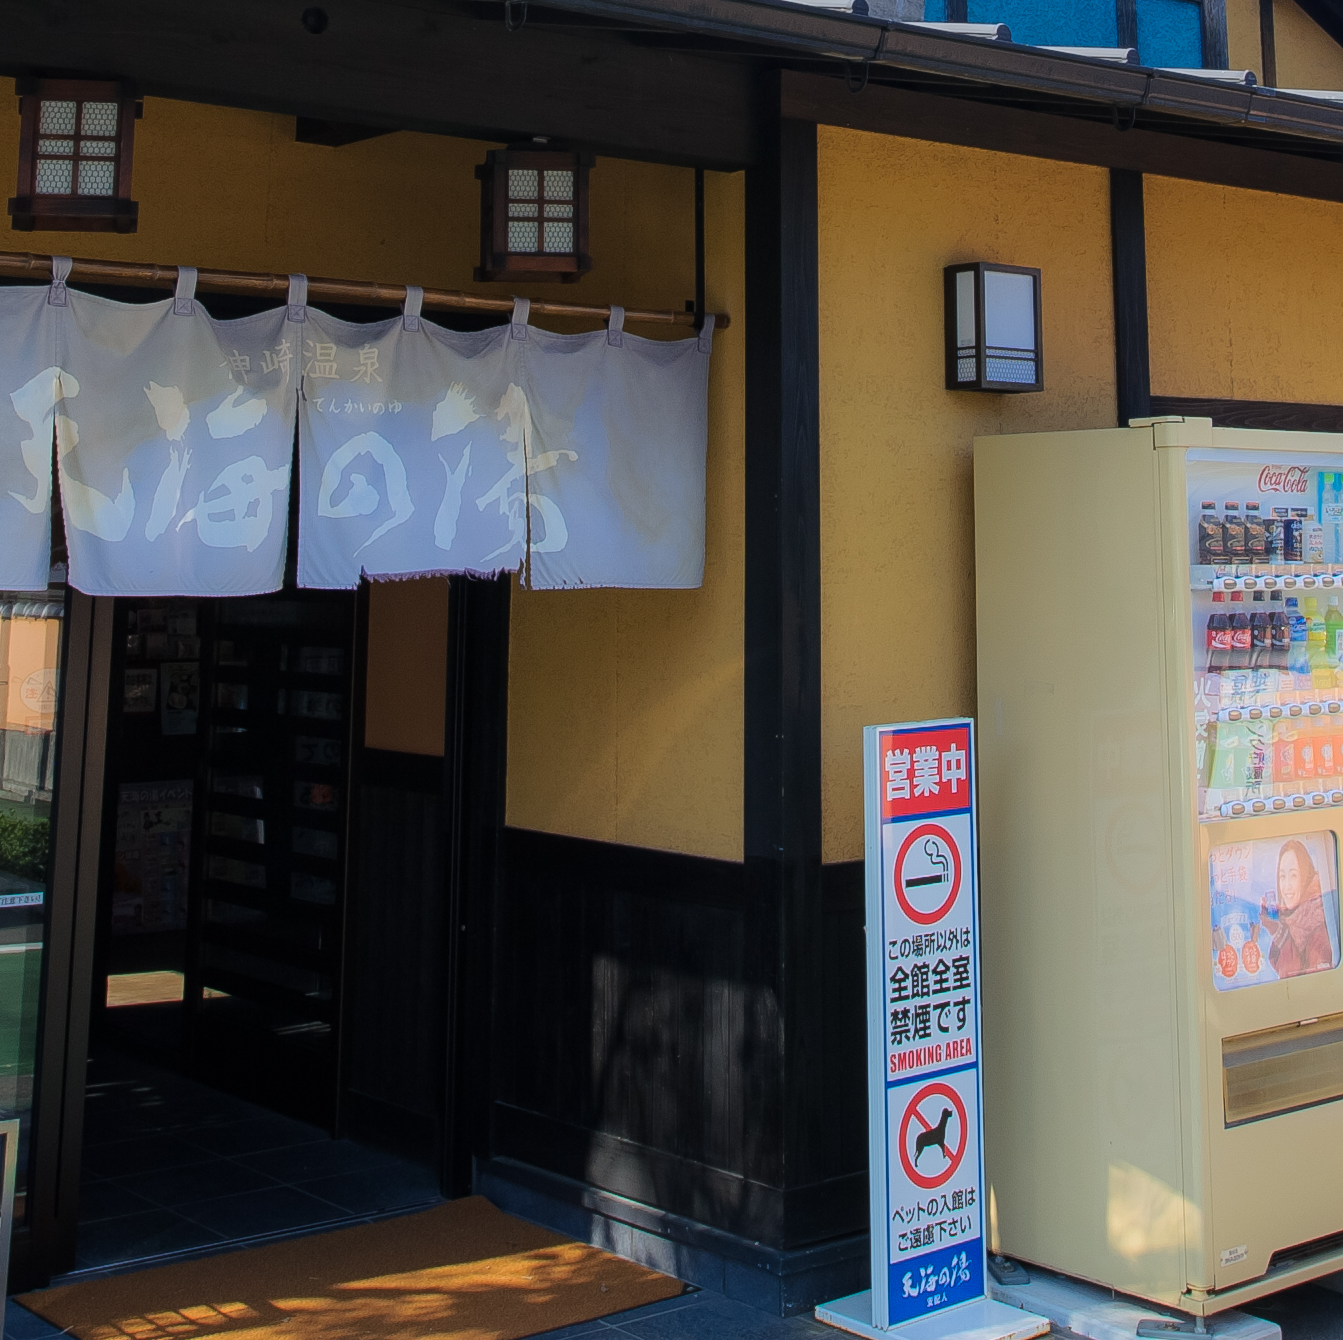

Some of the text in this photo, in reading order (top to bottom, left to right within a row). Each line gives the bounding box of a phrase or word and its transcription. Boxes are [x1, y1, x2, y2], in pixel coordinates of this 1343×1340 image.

[219, 338, 384, 385] 神崎温泉
[312, 397, 404, 416] てんかいのゆ
[7, 366, 579, 565] 天海の湯
[1258, 464, 1310, 493] Coca-Cola
[884, 743, 967, 801] 営業中
[1210, 845, 1252, 864] っとダウン
[1210, 866, 1249, 886] っと手袋
[888, 926, 971, 960] この場所以外は
[889, 955, 971, 1003] 全館全室
[890, 996, 971, 1046] 禁煙です
[889, 1037, 973, 1073] SMOKING AREA
[892, 1185, 976, 1224] ペットの入館は
[897, 1215, 973, 1252] ご遠慮下さい
[901, 1250, 973, 1299] 天海の湯
